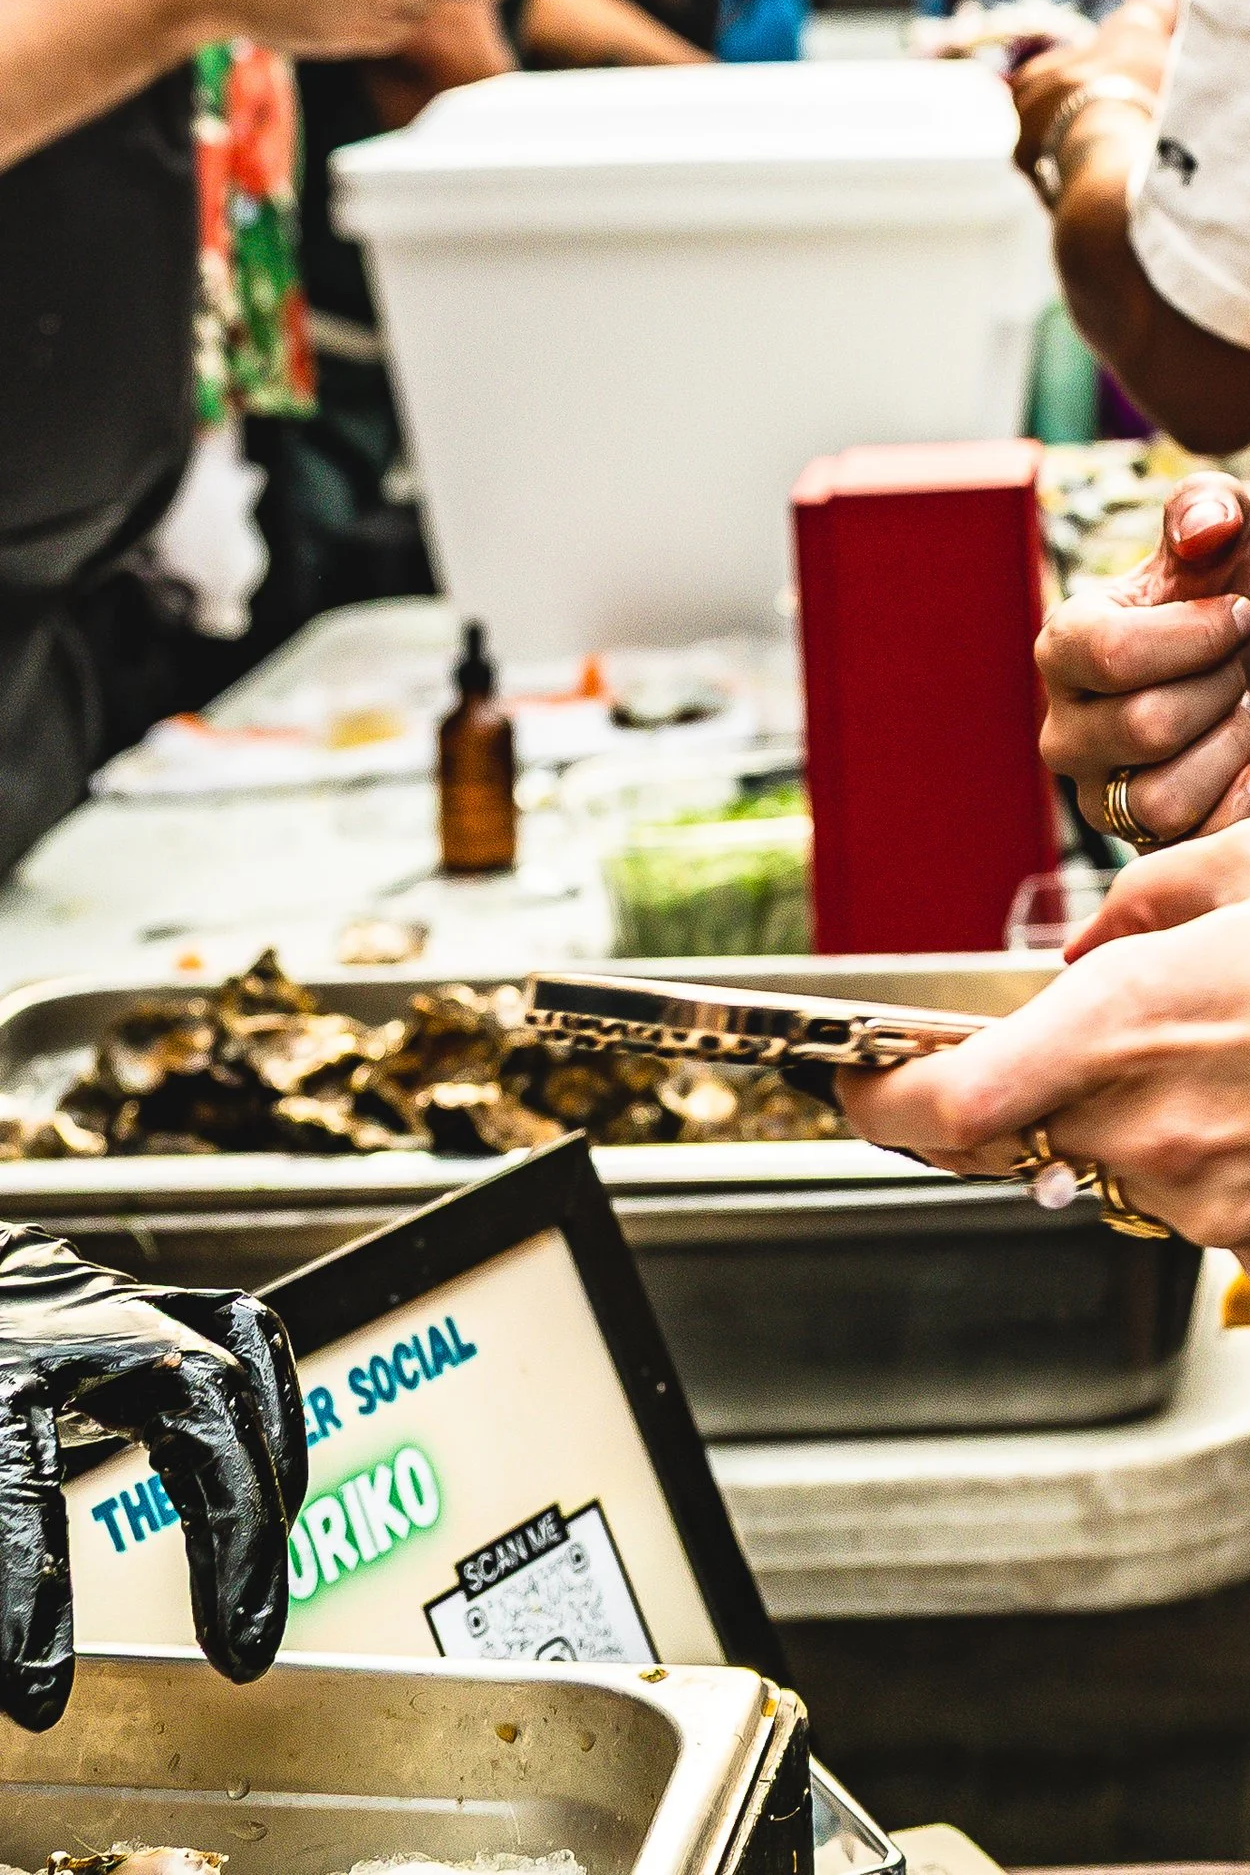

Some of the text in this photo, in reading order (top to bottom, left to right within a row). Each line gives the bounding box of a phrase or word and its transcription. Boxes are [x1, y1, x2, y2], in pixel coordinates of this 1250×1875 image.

[91, 1472, 180, 1553] THE
[348, 1316, 479, 1417] SOCIAL
[287, 1448, 440, 1601] ORIKO
[463, 1510, 563, 1592] SCAN ME
